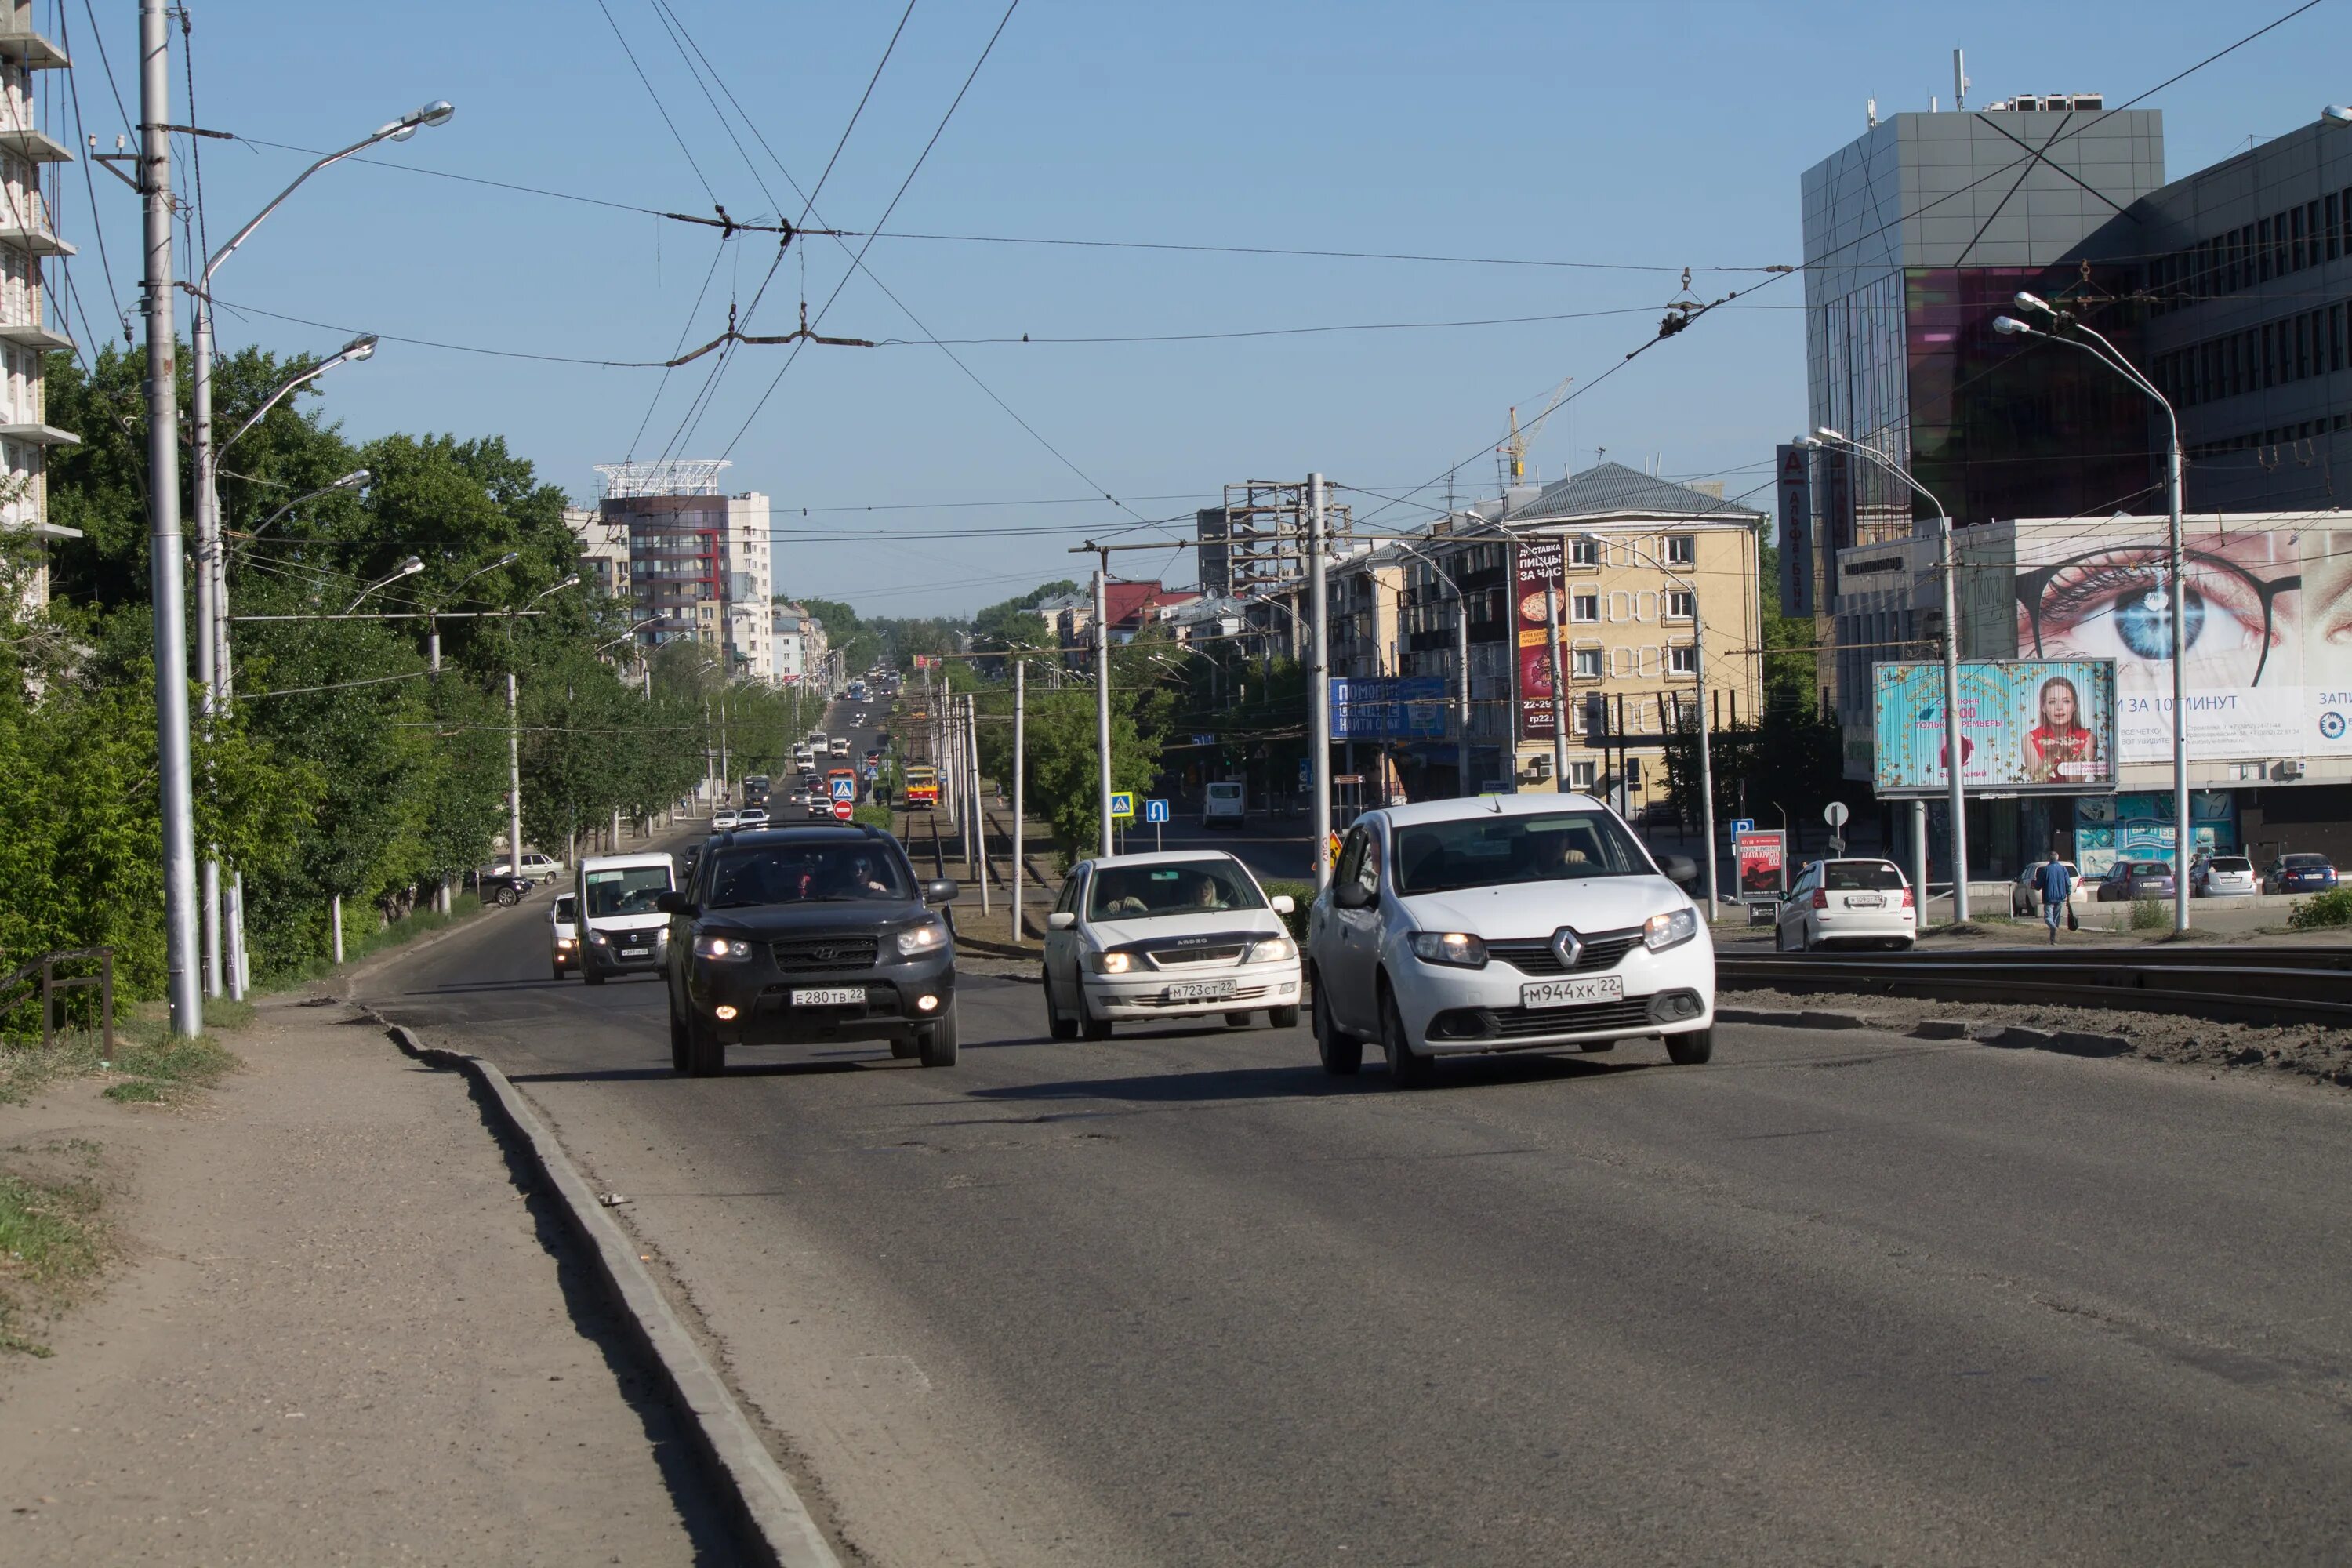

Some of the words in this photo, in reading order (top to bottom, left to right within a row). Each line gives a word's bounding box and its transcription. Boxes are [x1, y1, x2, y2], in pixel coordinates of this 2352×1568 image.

[1519, 554, 1562, 568] ПИЦЦЫ
[1520, 570, 1535, 581] ЗА
[1537, 567, 1562, 578] ЧАС
[1338, 684, 1399, 701] ПОМОГТЕ
[2129, 699, 2149, 713] ЗА
[2155, 698, 2172, 712] 10
[1339, 717, 1373, 731] НАЙТИ
[1915, 720, 1946, 729] ТОЛЬК
[1962, 720, 2004, 728] РЕМЬЕРЫ
[796, 991, 847, 1004] Е280ТВ
[850, 989, 862, 999] 22
[1173, 985, 1218, 997] М723СТ
[1221, 982, 1232, 991] 22
[1530, 983, 1595, 1002] М944ХК
[1600, 978, 1617, 991] 22
